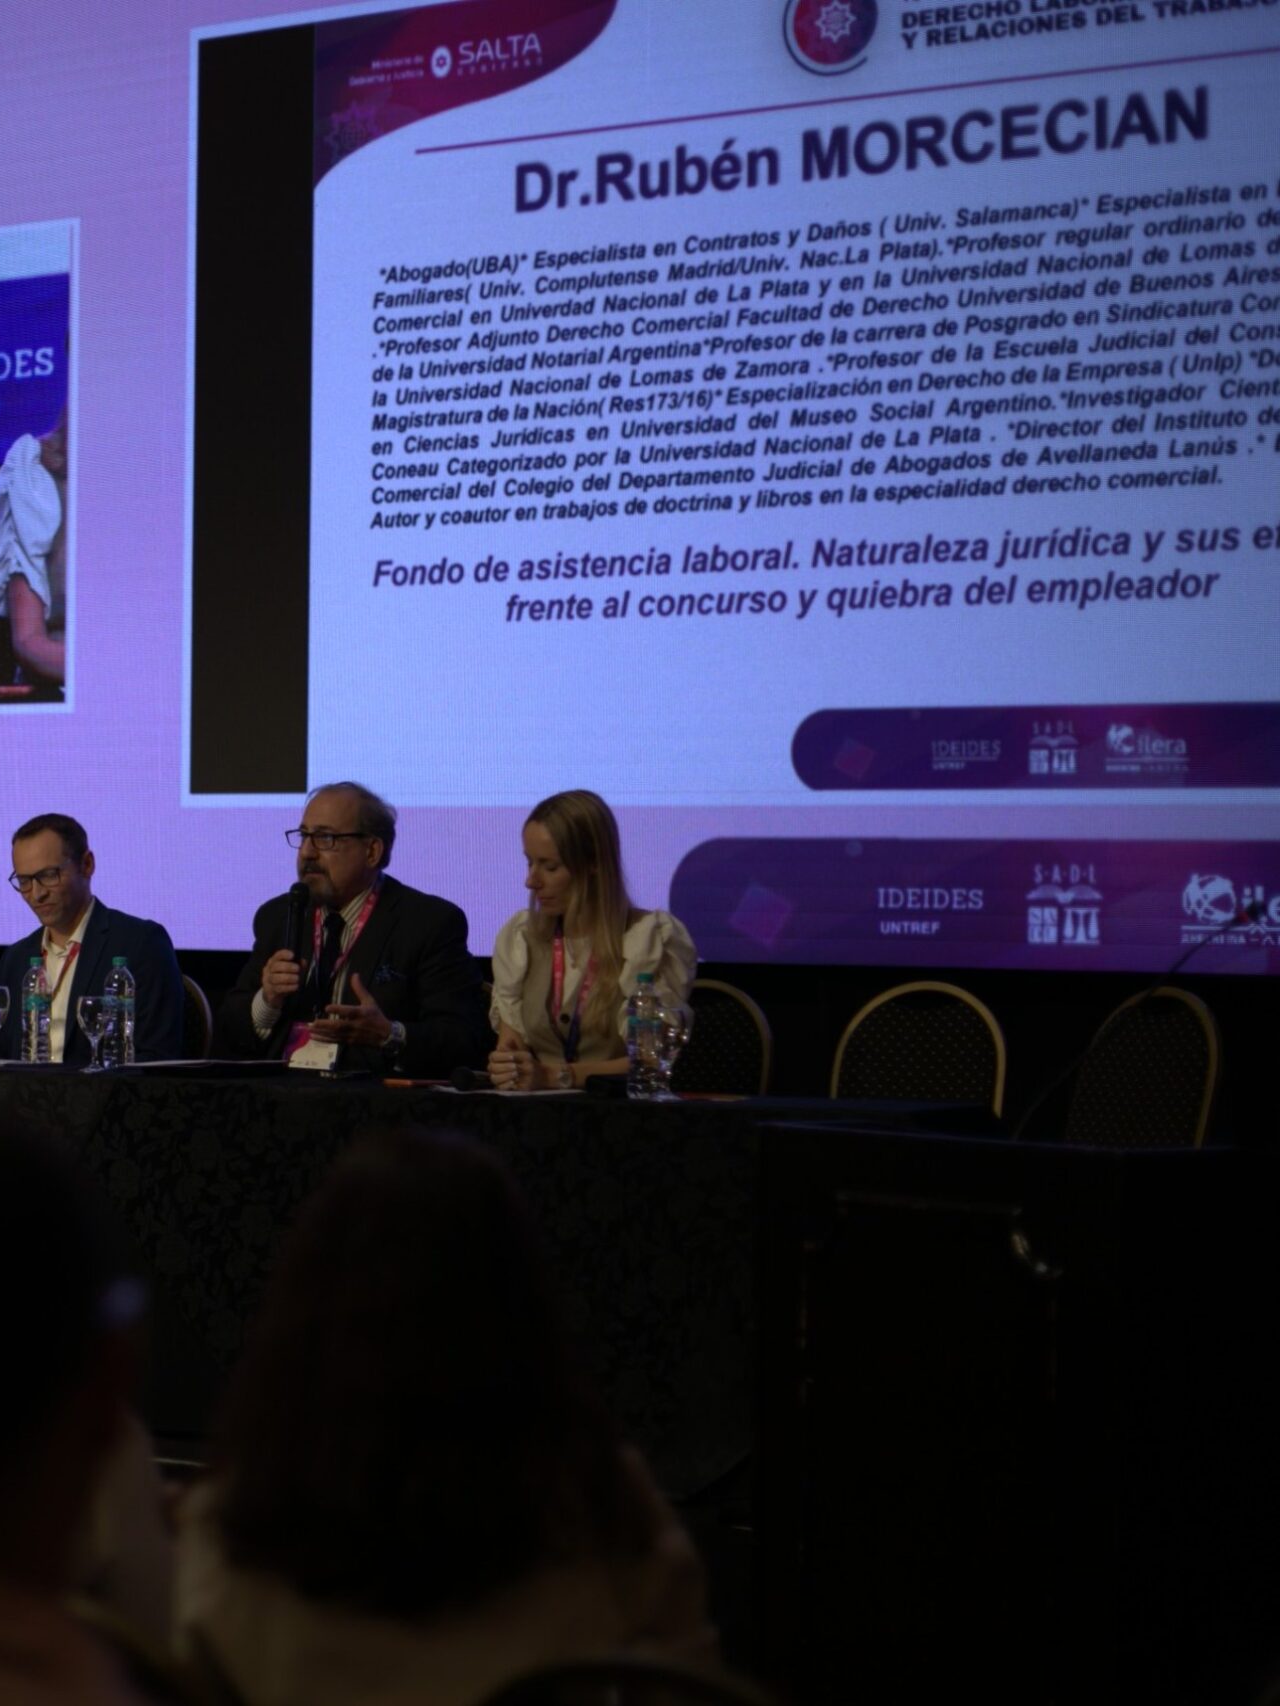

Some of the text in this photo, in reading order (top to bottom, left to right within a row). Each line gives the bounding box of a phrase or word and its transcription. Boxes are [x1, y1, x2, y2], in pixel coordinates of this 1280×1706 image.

[458, 32, 542, 65] SALTA
[901, 31, 918, 49] Y
[926, 10, 1087, 47] RELACIONES
[1096, 4, 1146, 26] DEL
[514, 84, 1210, 214] Dr.Rubén MORCECIAN
[534, 241, 646, 271] Especialista
[653, 242, 676, 257] en
[684, 229, 780, 254] Contratos
[787, 230, 800, 249] y
[807, 221, 871, 242] Daños
[895, 213, 946, 233] Univ.
[1096, 185, 1231, 216] Especialista
[1240, 185, 1267, 201] en
[467, 327, 539, 353] Adjunto
[547, 320, 624, 343] Derecho
[632, 310, 729, 336] Comercial
[736, 302, 822, 327] Facultad
[830, 301, 854, 319] de
[862, 293, 949, 316] Derecho
[957, 280, 1086, 309] Universidad
[1094, 279, 1120, 297] de
[1129, 275, 1213, 294] Buenos
[372, 389, 387, 407] la
[395, 379, 502, 405] Universidad
[510, 372, 590, 396] Nacional
[598, 371, 621, 389] de
[630, 368, 693, 387] Lomas
[702, 363, 726, 381] de
[735, 360, 809, 379] Zamora
[931, 346, 957, 364] de
[965, 344, 983, 361] la
[993, 337, 1078, 359] Escuela
[1089, 329, 1175, 352] Judicial
[1185, 326, 1218, 345] del
[372, 407, 483, 434] Magistratura
[487, 404, 509, 422] de
[514, 402, 529, 420] la
[726, 377, 881, 408] Especialización
[887, 379, 912, 393] en
[918, 369, 1005, 391] Derecho
[1011, 367, 1037, 385] de
[1042, 365, 1060, 383] la
[1066, 362, 1163, 384] Empresa
[372, 462, 438, 481] Coneau
[447, 451, 567, 478] Categorizado
[574, 452, 608, 473] por
[615, 447, 630, 465] la
[639, 438, 756, 463] Universidad
[764, 432, 852, 455] Nacional
[861, 431, 885, 449] de
[894, 429, 918, 447] La
[929, 425, 980, 445] Plata
[1112, 415, 1145, 434] del
[1154, 409, 1247, 431] Instituto
[372, 482, 461, 504] Comercial
[468, 480, 495, 499] del
[504, 476, 574, 499] Colegio
[582, 473, 610, 492] del
[618, 465, 754, 493] Departamento
[763, 460, 842, 482] Judicial
[850, 458, 875, 477] de
[884, 452, 991, 477] Abogados
[1001, 450, 1028, 468] de
[1036, 442, 1158, 466] Avellaneda
[370, 466, 1222, 531] Autor y coautor en trabajos de doctrina y libros en la especialidad derecho comercial.
[373, 521, 1280, 587] Fondo de asistencia laboral. Naturaleza jurídica y sus e
[505, 572, 1220, 623] frente al concurso y quiebra del empleador
[931, 739, 1003, 758] IDEIDES
[877, 887, 984, 910] IDEIDES
[880, 921, 941, 935] UNTREF
